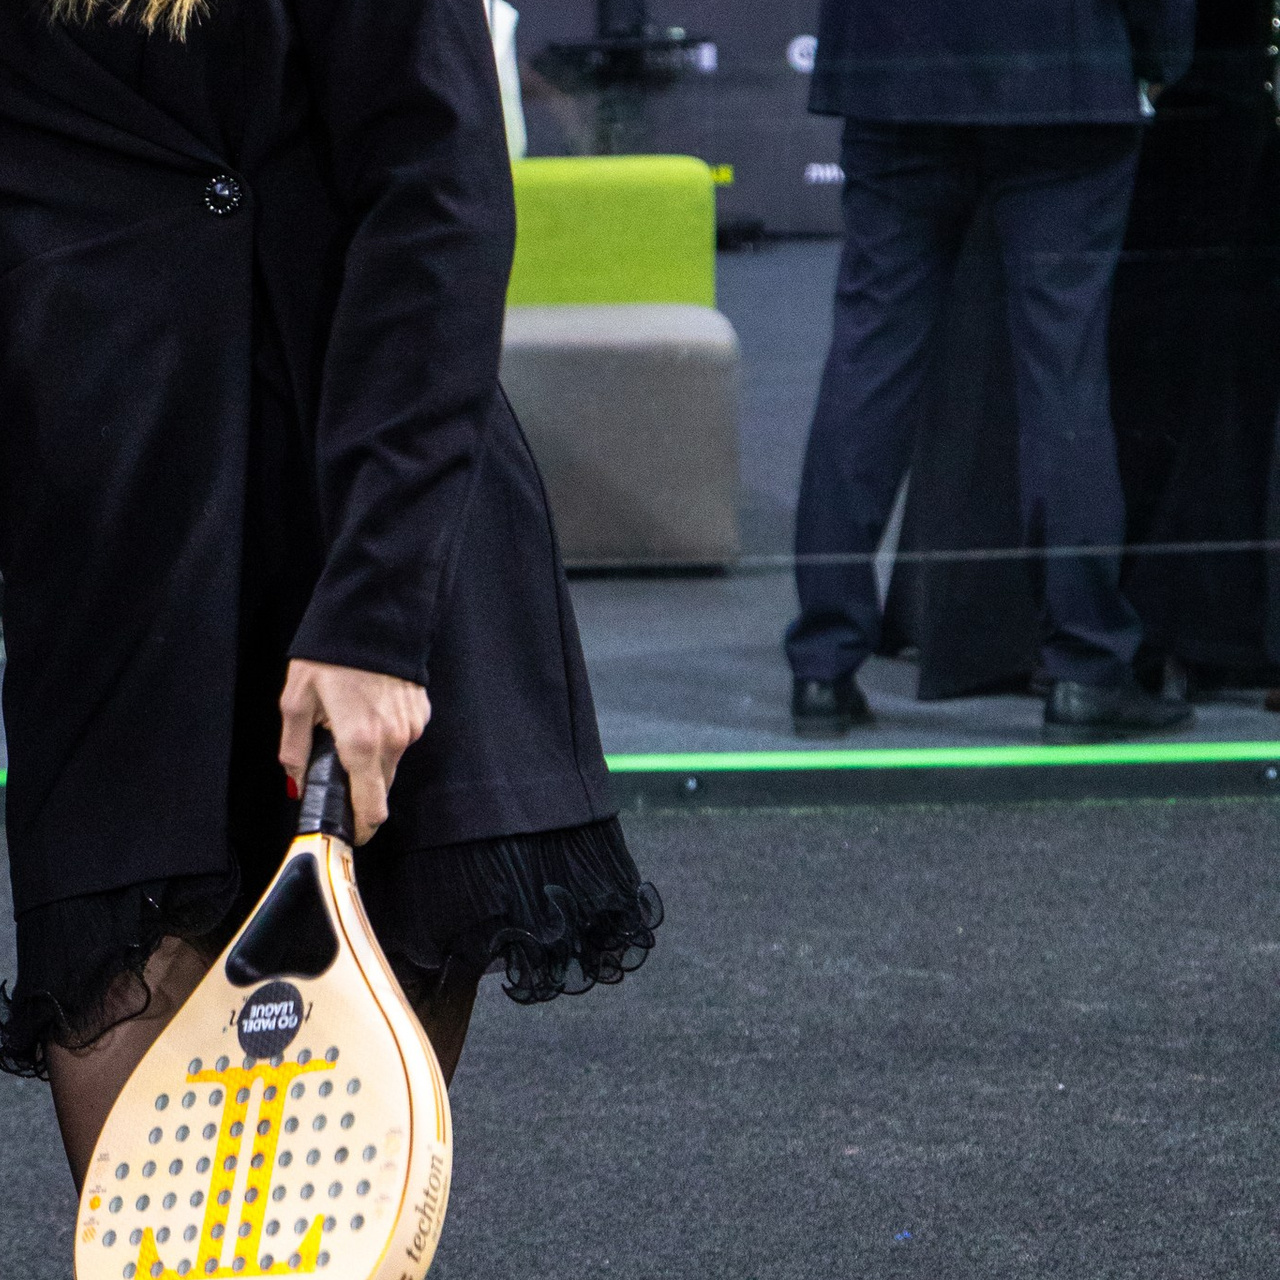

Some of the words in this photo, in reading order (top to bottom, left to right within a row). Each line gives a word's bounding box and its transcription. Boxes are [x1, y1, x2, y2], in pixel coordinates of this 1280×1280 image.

[249, 1000, 295, 1018] LEAGUE
[242, 1016, 277, 1033] PADEL
[279, 1015, 298, 1028] GO
[404, 1154, 444, 1264] techton
